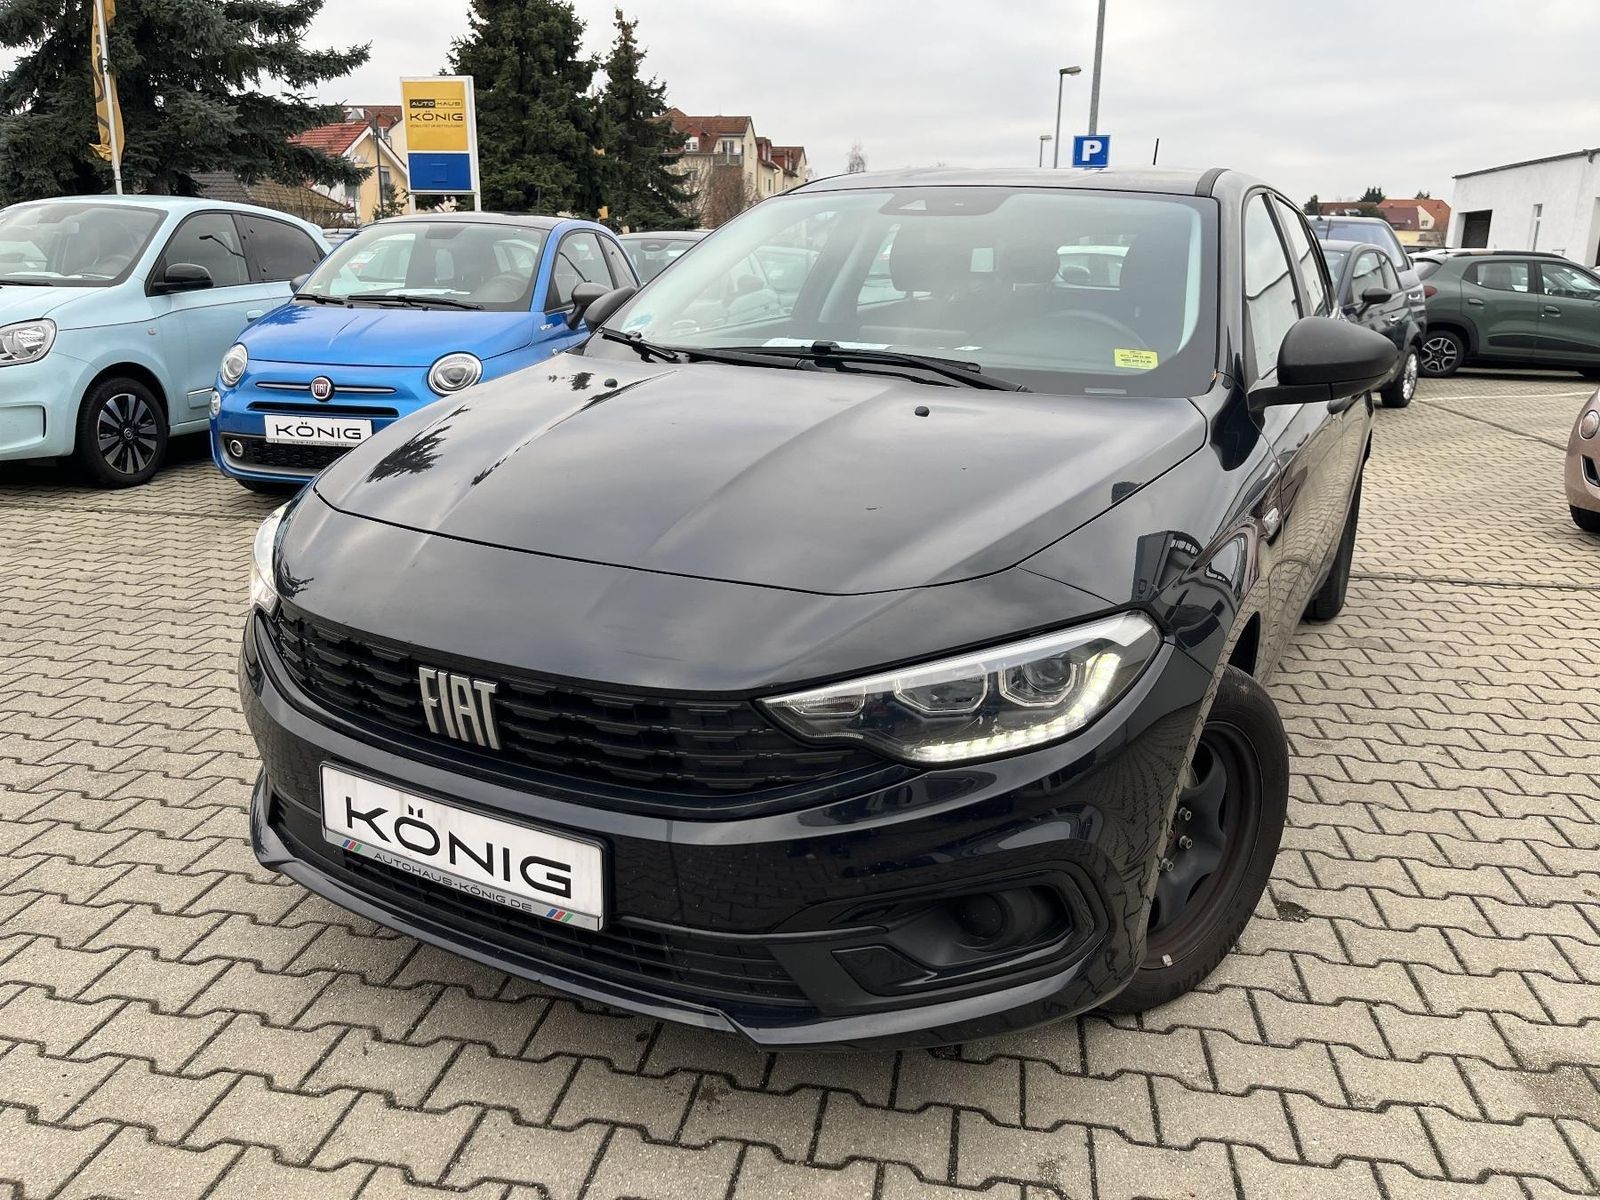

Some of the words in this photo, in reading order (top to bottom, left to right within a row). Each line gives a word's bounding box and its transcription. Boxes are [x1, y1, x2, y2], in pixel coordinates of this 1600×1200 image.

[410, 110, 463, 121] KÖNIG
[1081, 140, 1102, 162] P
[315, 383, 327, 394] FIAT
[275, 421, 362, 440] KÖNIG
[418, 665, 501, 750] FIAT
[345, 796, 572, 899] KÖNIG
[374, 852, 533, 912] AUTOHAUS-KÖNIG.DE
